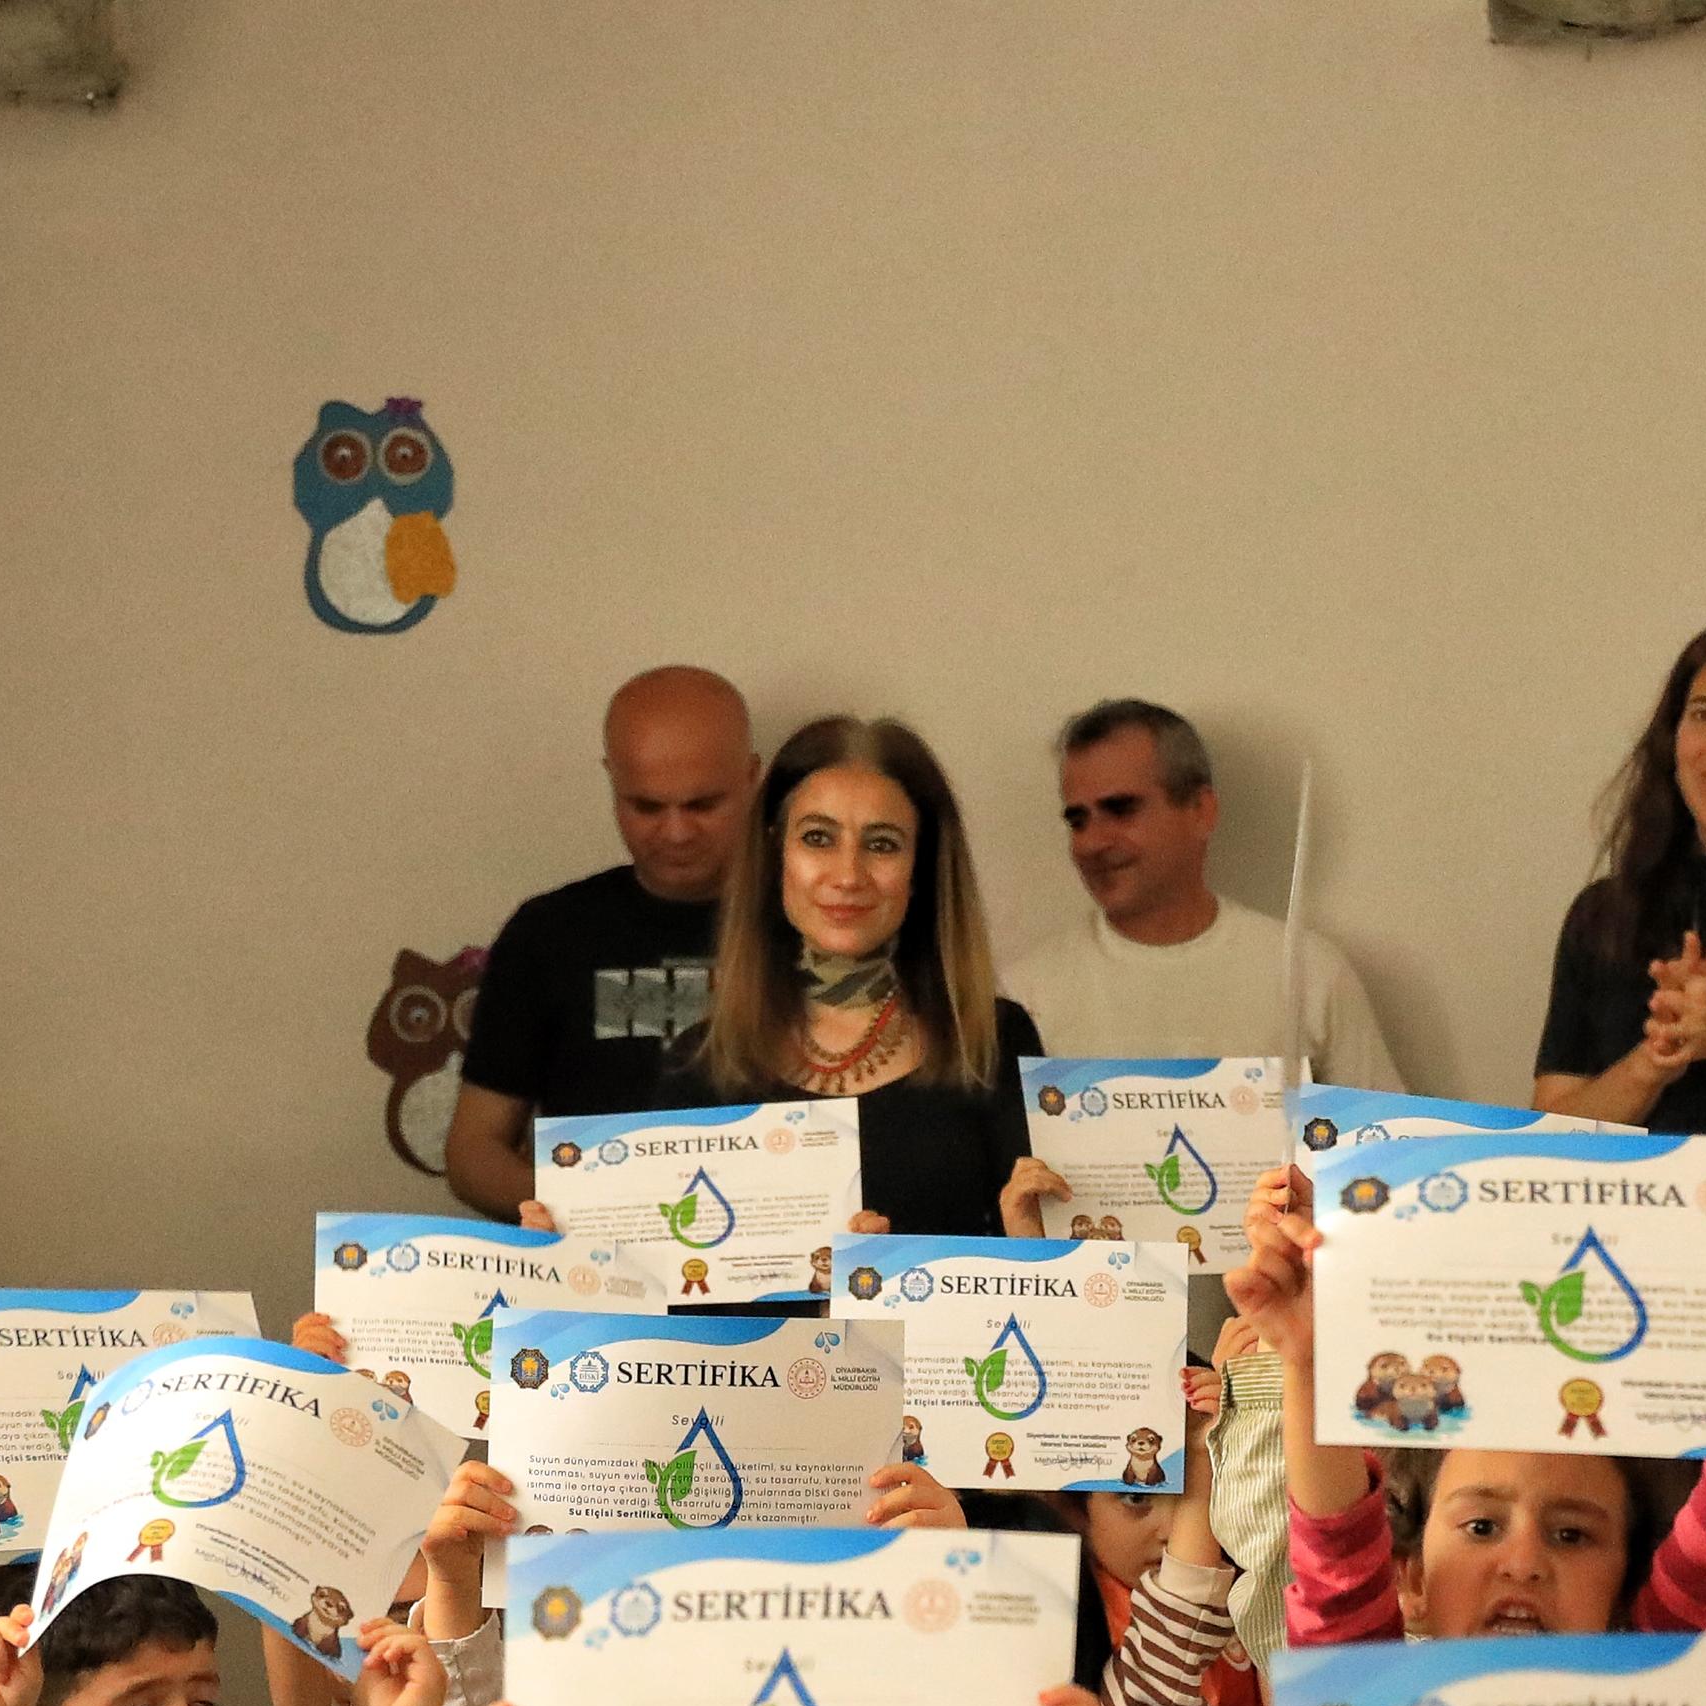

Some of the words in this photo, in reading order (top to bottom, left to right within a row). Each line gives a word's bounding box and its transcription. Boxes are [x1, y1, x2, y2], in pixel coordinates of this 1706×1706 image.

[1113, 1088, 1226, 1109] SERTİFİKA
[634, 1135, 759, 1157] SERTİFİKA
[1478, 1178, 1686, 1208] SERTİFİKA
[426, 1250, 561, 1283] SERTİFİKA
[940, 1274, 1078, 1297] SERTİFİKA
[617, 1360, 781, 1388] SERTİFİKA
[831, 1374, 839, 1382] İL
[857, 1374, 881, 1383] EĞİTİM
[835, 1366, 877, 1374] DİYARBAKIR
[157, 1371, 322, 1419] SERTİFİKA
[833, 1382, 878, 1391] MÜDÜRLÜĞÜ
[530, 1453, 560, 1466] Suyun
[564, 1454, 637, 1469] dünyamızdaki
[781, 1463, 791, 1471] su
[796, 1461, 863, 1474] kaynaklarının
[529, 1465, 585, 1480] korunması,
[589, 1470, 620, 1481] suyun
[755, 1476, 766, 1484] su
[771, 1474, 821, 1486] tasarrufu,
[825, 1474, 861, 1484] küresel
[527, 1481, 561, 1489] ısınma
[565, 1480, 577, 1490] ile
[581, 1481, 615, 1495] ortaya
[620, 1483, 647, 1496] çıkan
[805, 1487, 830, 1497] DİSKİ
[833, 1487, 862, 1497] Genel
[534, 1491, 609, 1507] Müdürlüğünün
[614, 1495, 649, 1508] verdiği
[775, 1499, 851, 1512] tamamlayarak
[569, 1505, 581, 1516] Su
[586, 1506, 613, 1520] Elçisi
[757, 1511, 819, 1524] kazanmıştır.
[671, 1583, 893, 1622] SERTİFİKA
